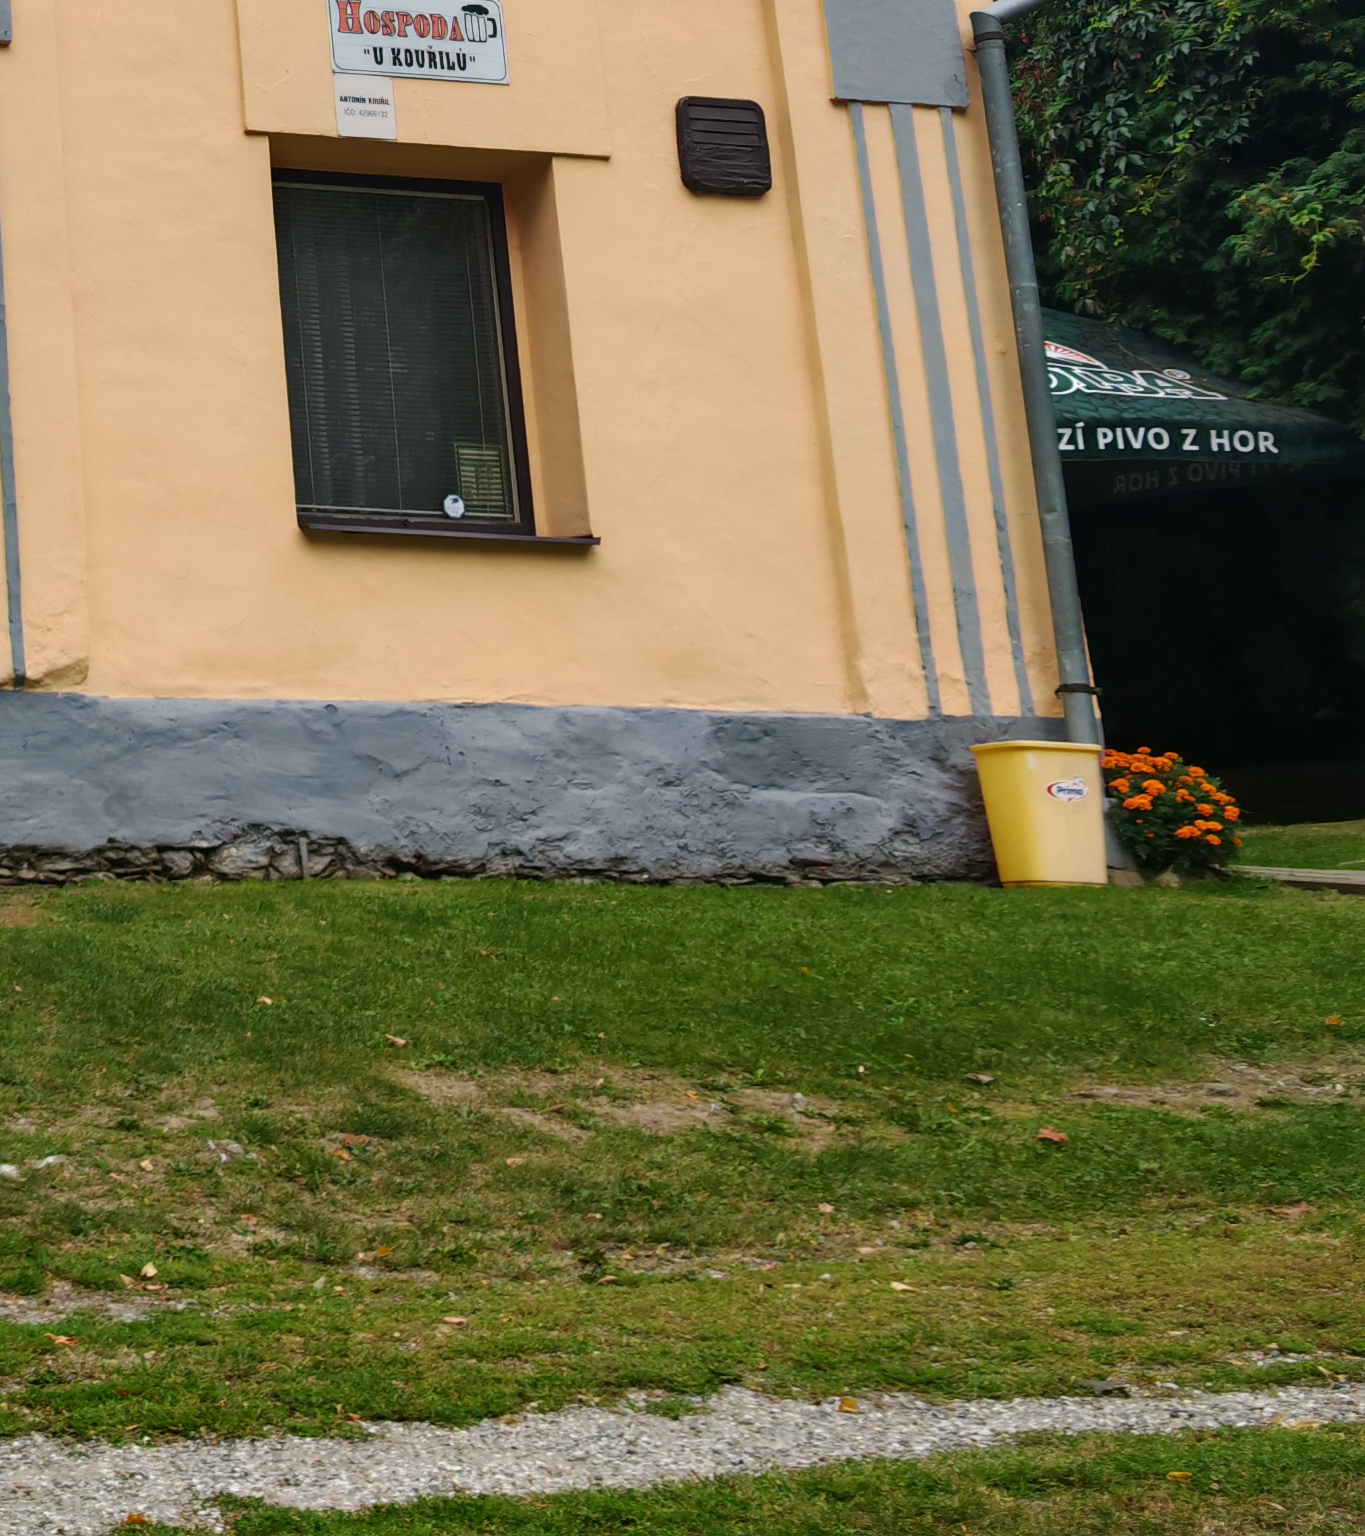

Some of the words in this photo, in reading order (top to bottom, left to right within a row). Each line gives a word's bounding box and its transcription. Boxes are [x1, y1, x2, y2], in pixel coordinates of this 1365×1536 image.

[1057, 422, 1086, 450] ZÍ
[1096, 427, 1171, 451] PIVO
[1180, 428, 1200, 451] Z
[1210, 430, 1279, 454] HOR
